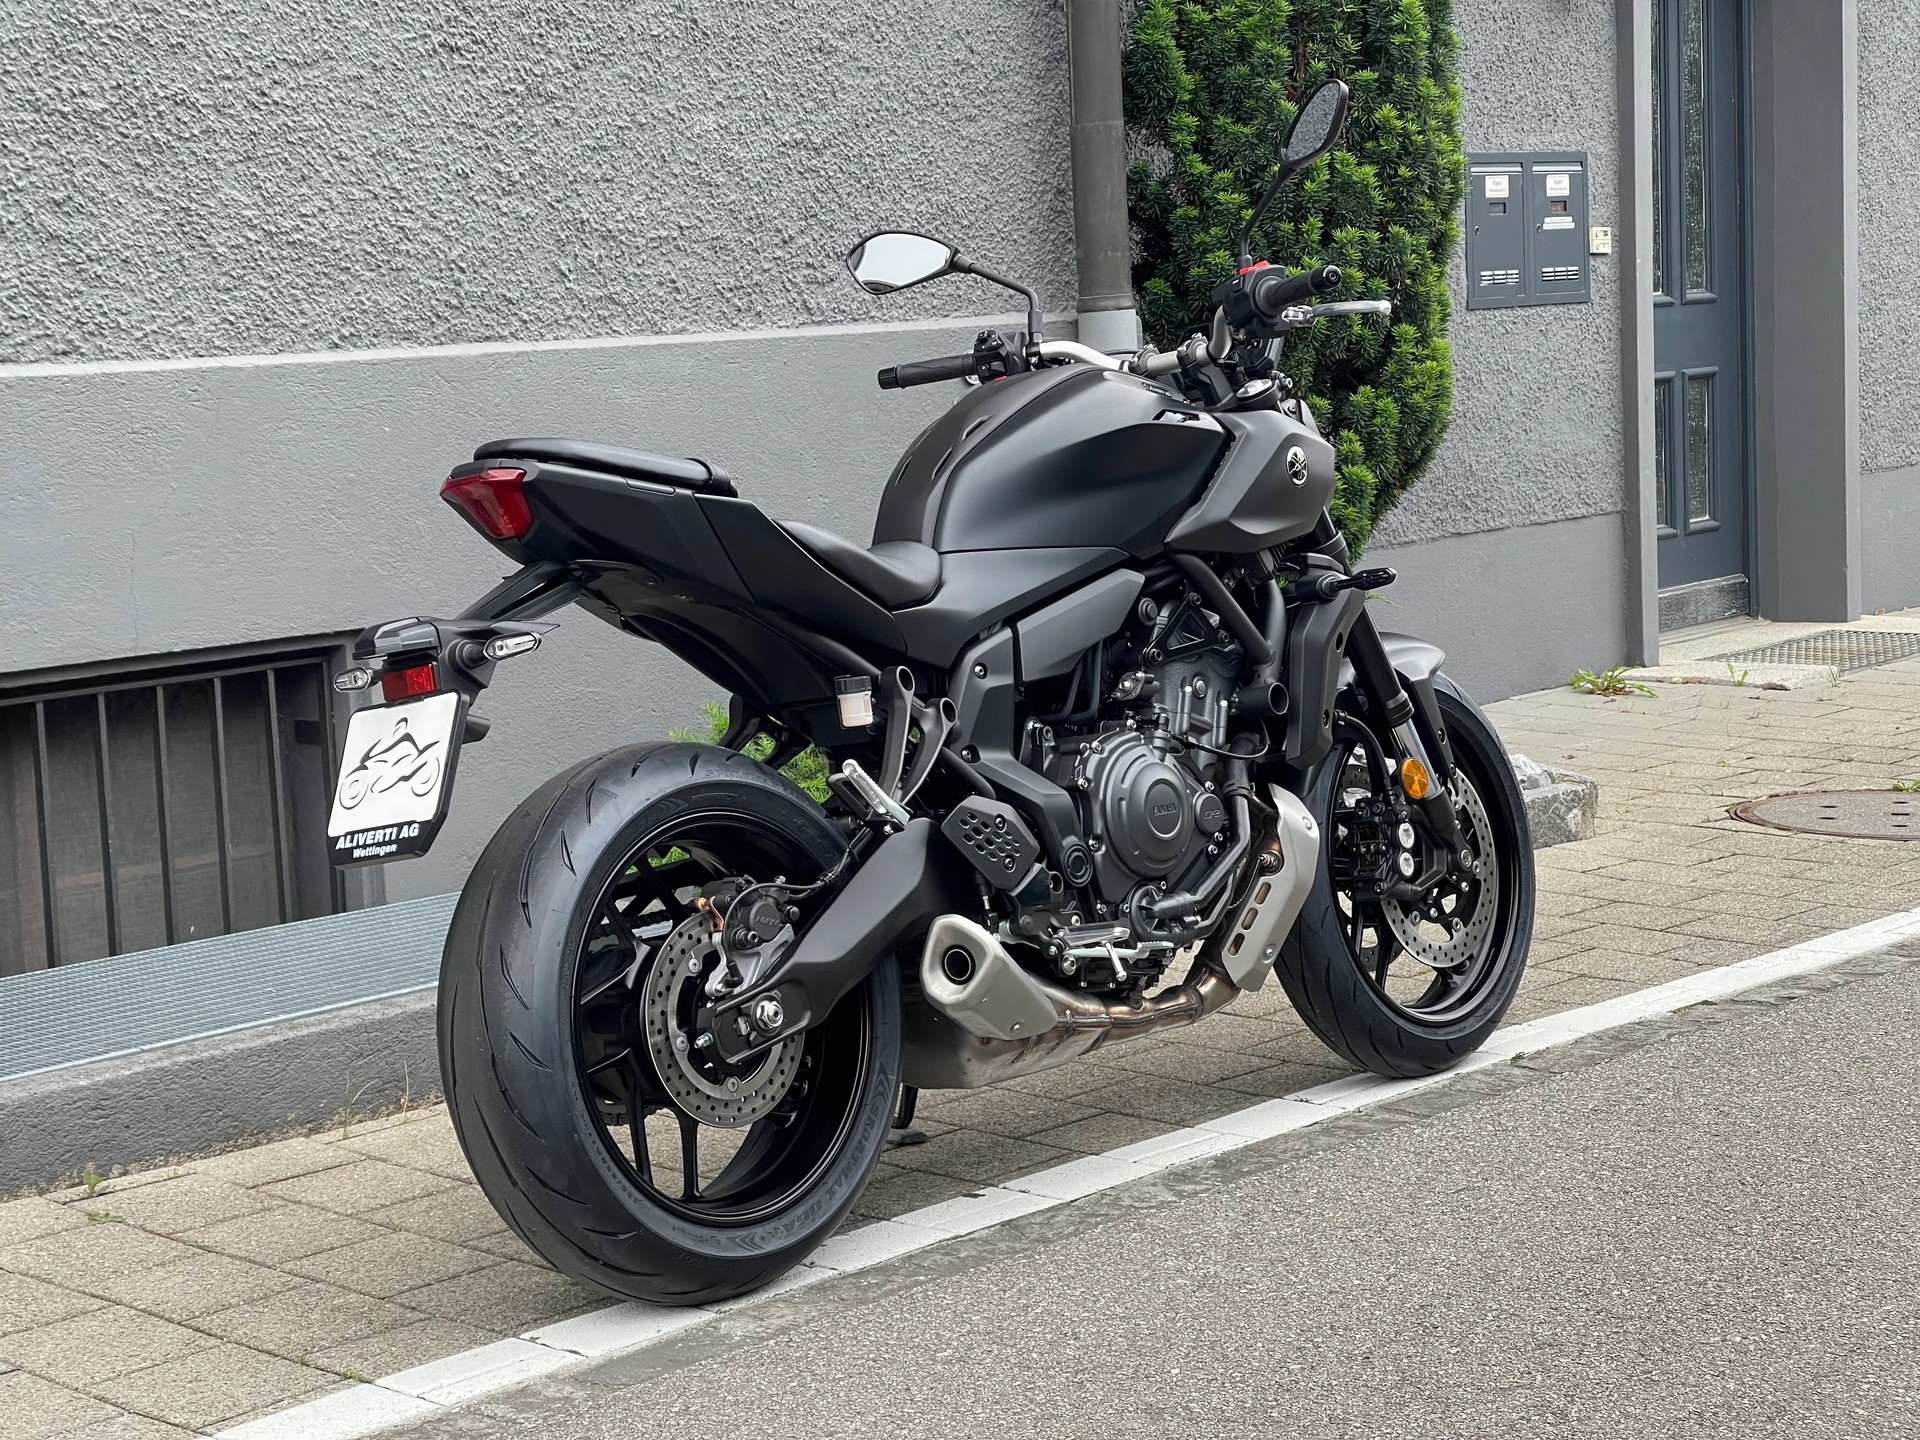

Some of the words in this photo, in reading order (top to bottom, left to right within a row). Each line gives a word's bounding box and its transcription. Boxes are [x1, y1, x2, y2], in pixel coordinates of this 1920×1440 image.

[335, 826, 398, 850] ALIVERTI
[399, 822, 420, 839] AG
[352, 843, 397, 859] Wettingen
